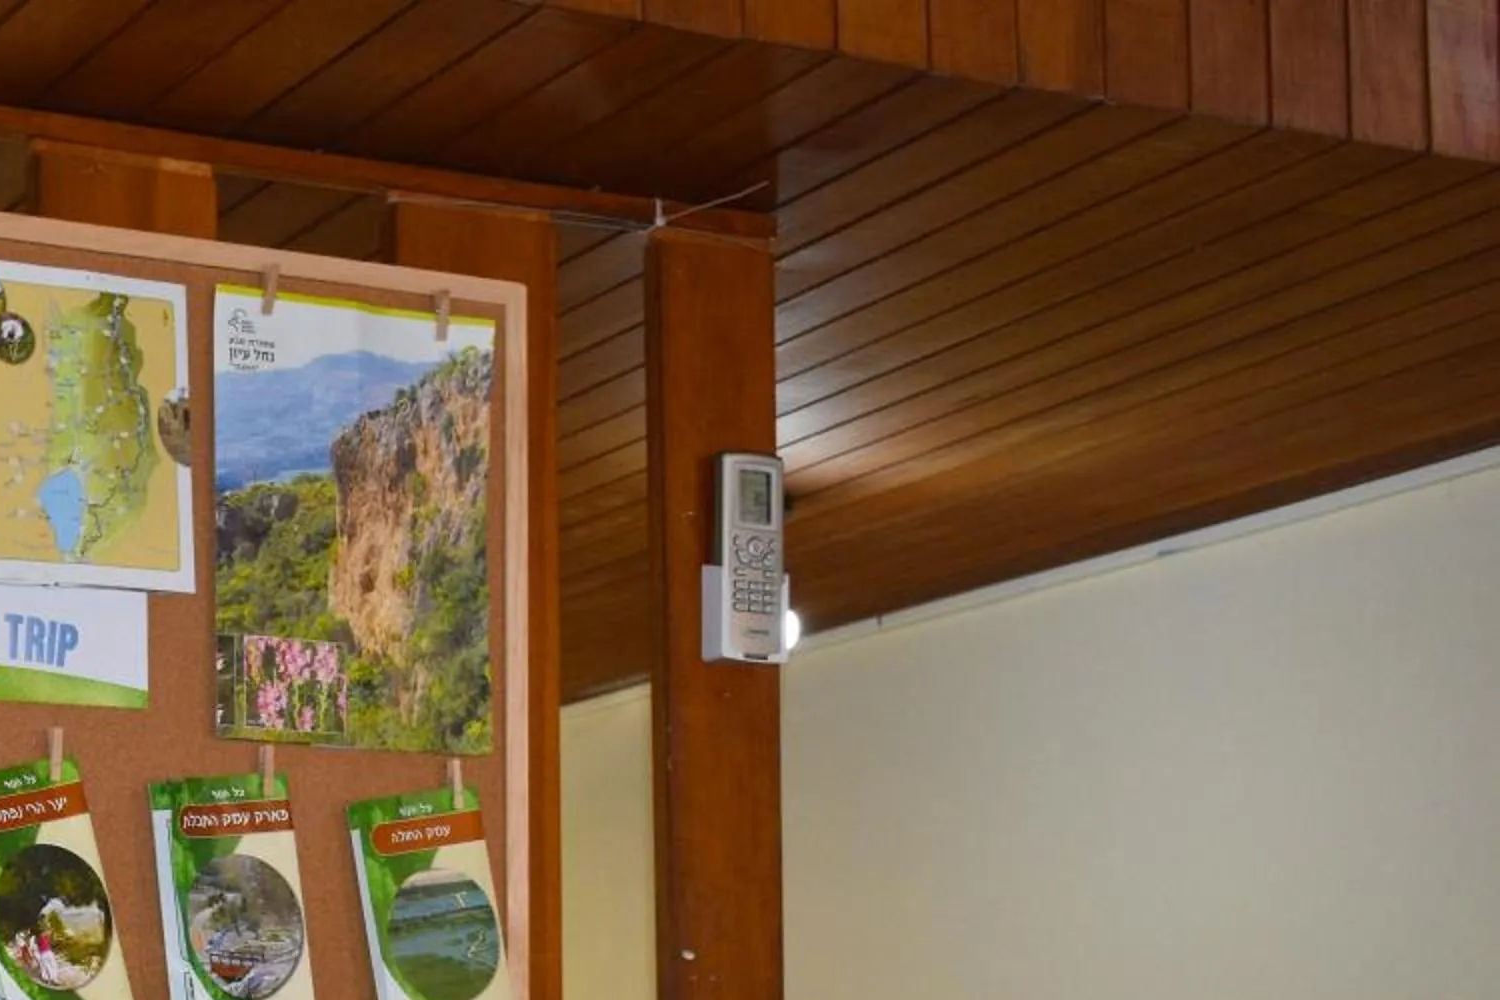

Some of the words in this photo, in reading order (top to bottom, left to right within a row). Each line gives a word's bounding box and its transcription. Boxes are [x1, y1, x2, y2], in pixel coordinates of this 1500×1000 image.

[229, 347, 251, 362] עיון
[253, 348, 275, 363] נחל
[4, 613, 79, 668] TRIP
[47, 797, 68, 812] יער
[221, 812, 251, 827] עמק
[255, 809, 289, 825] פארק
[425, 824, 451, 840] עמק
